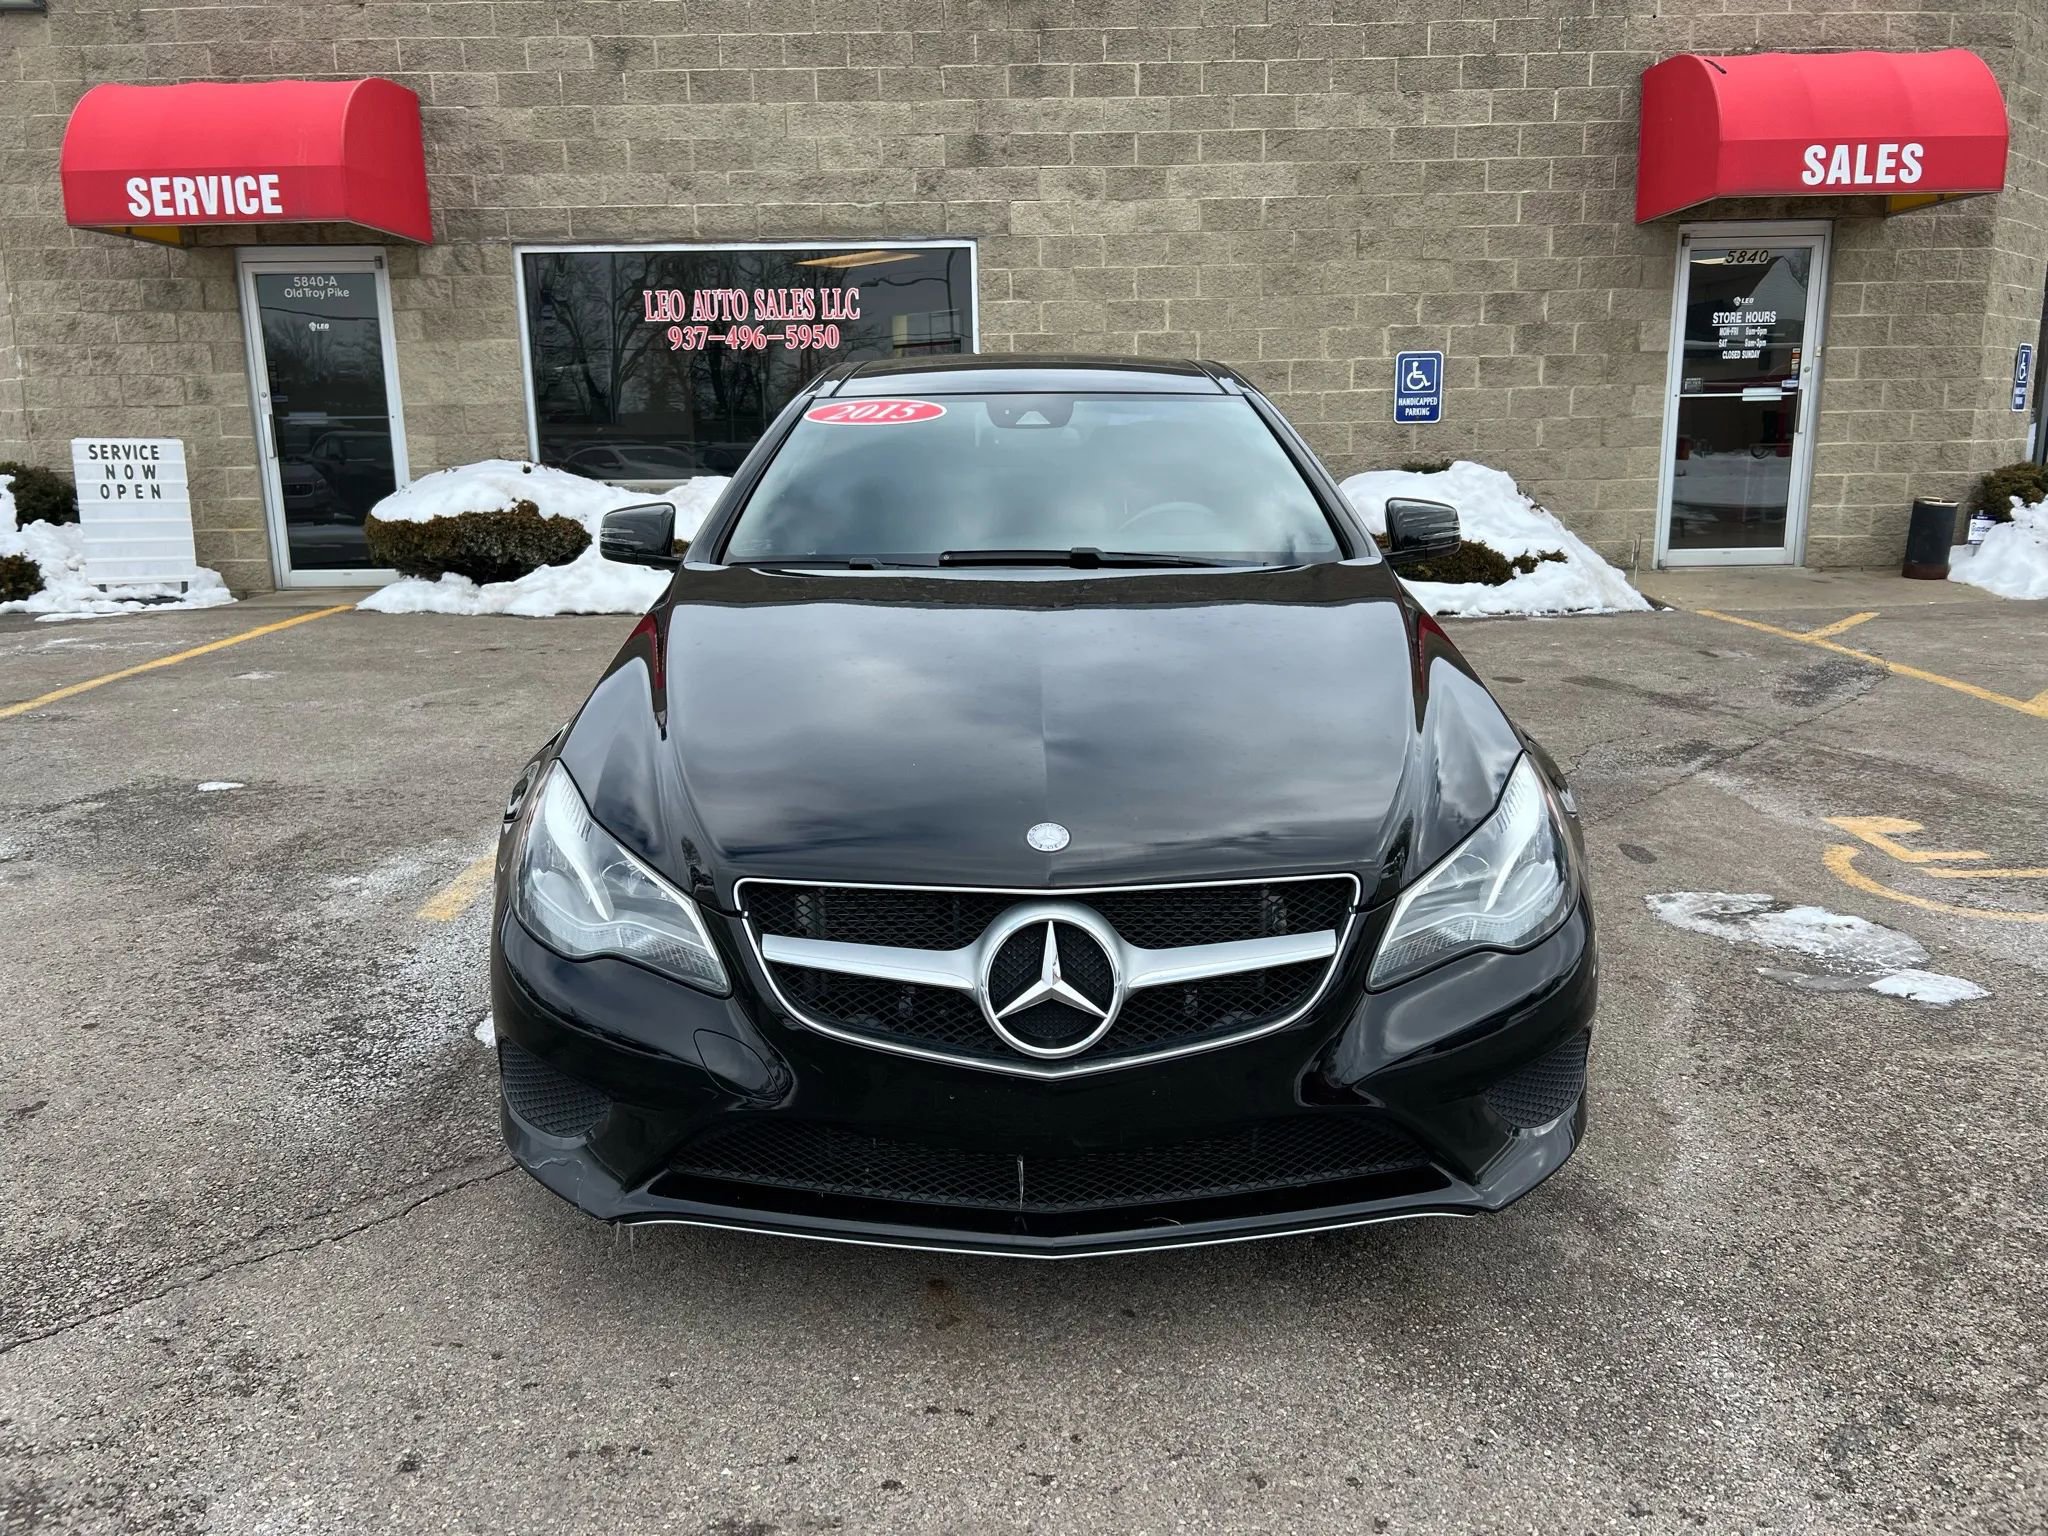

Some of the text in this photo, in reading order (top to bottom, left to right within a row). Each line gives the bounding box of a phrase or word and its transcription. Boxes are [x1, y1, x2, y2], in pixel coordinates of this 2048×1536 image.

[1802, 143, 1924, 185] SALES
[126, 174, 283, 217] SERVICE
[1726, 250, 1769, 263] 5840
[293, 276, 338, 287] 5840-A
[284, 288, 350, 299] Old Troy Pike
[643, 287, 860, 322] LEO AUTO SALES LLC
[1712, 311, 1777, 323] STORE HOURS
[667, 324, 840, 350] 937-496-5950
[1718, 339, 1728, 348] SAT
[1722, 350, 1761, 360] CLOSED SUNDAY
[1398, 397, 1438, 406] HANDICAPPED
[823, 403, 925, 421] 2015
[1405, 407, 1430, 416] PARKING
[88, 444, 160, 460] SERVICE
[105, 464, 156, 480] NOW
[100, 484, 162, 500] OPEN
